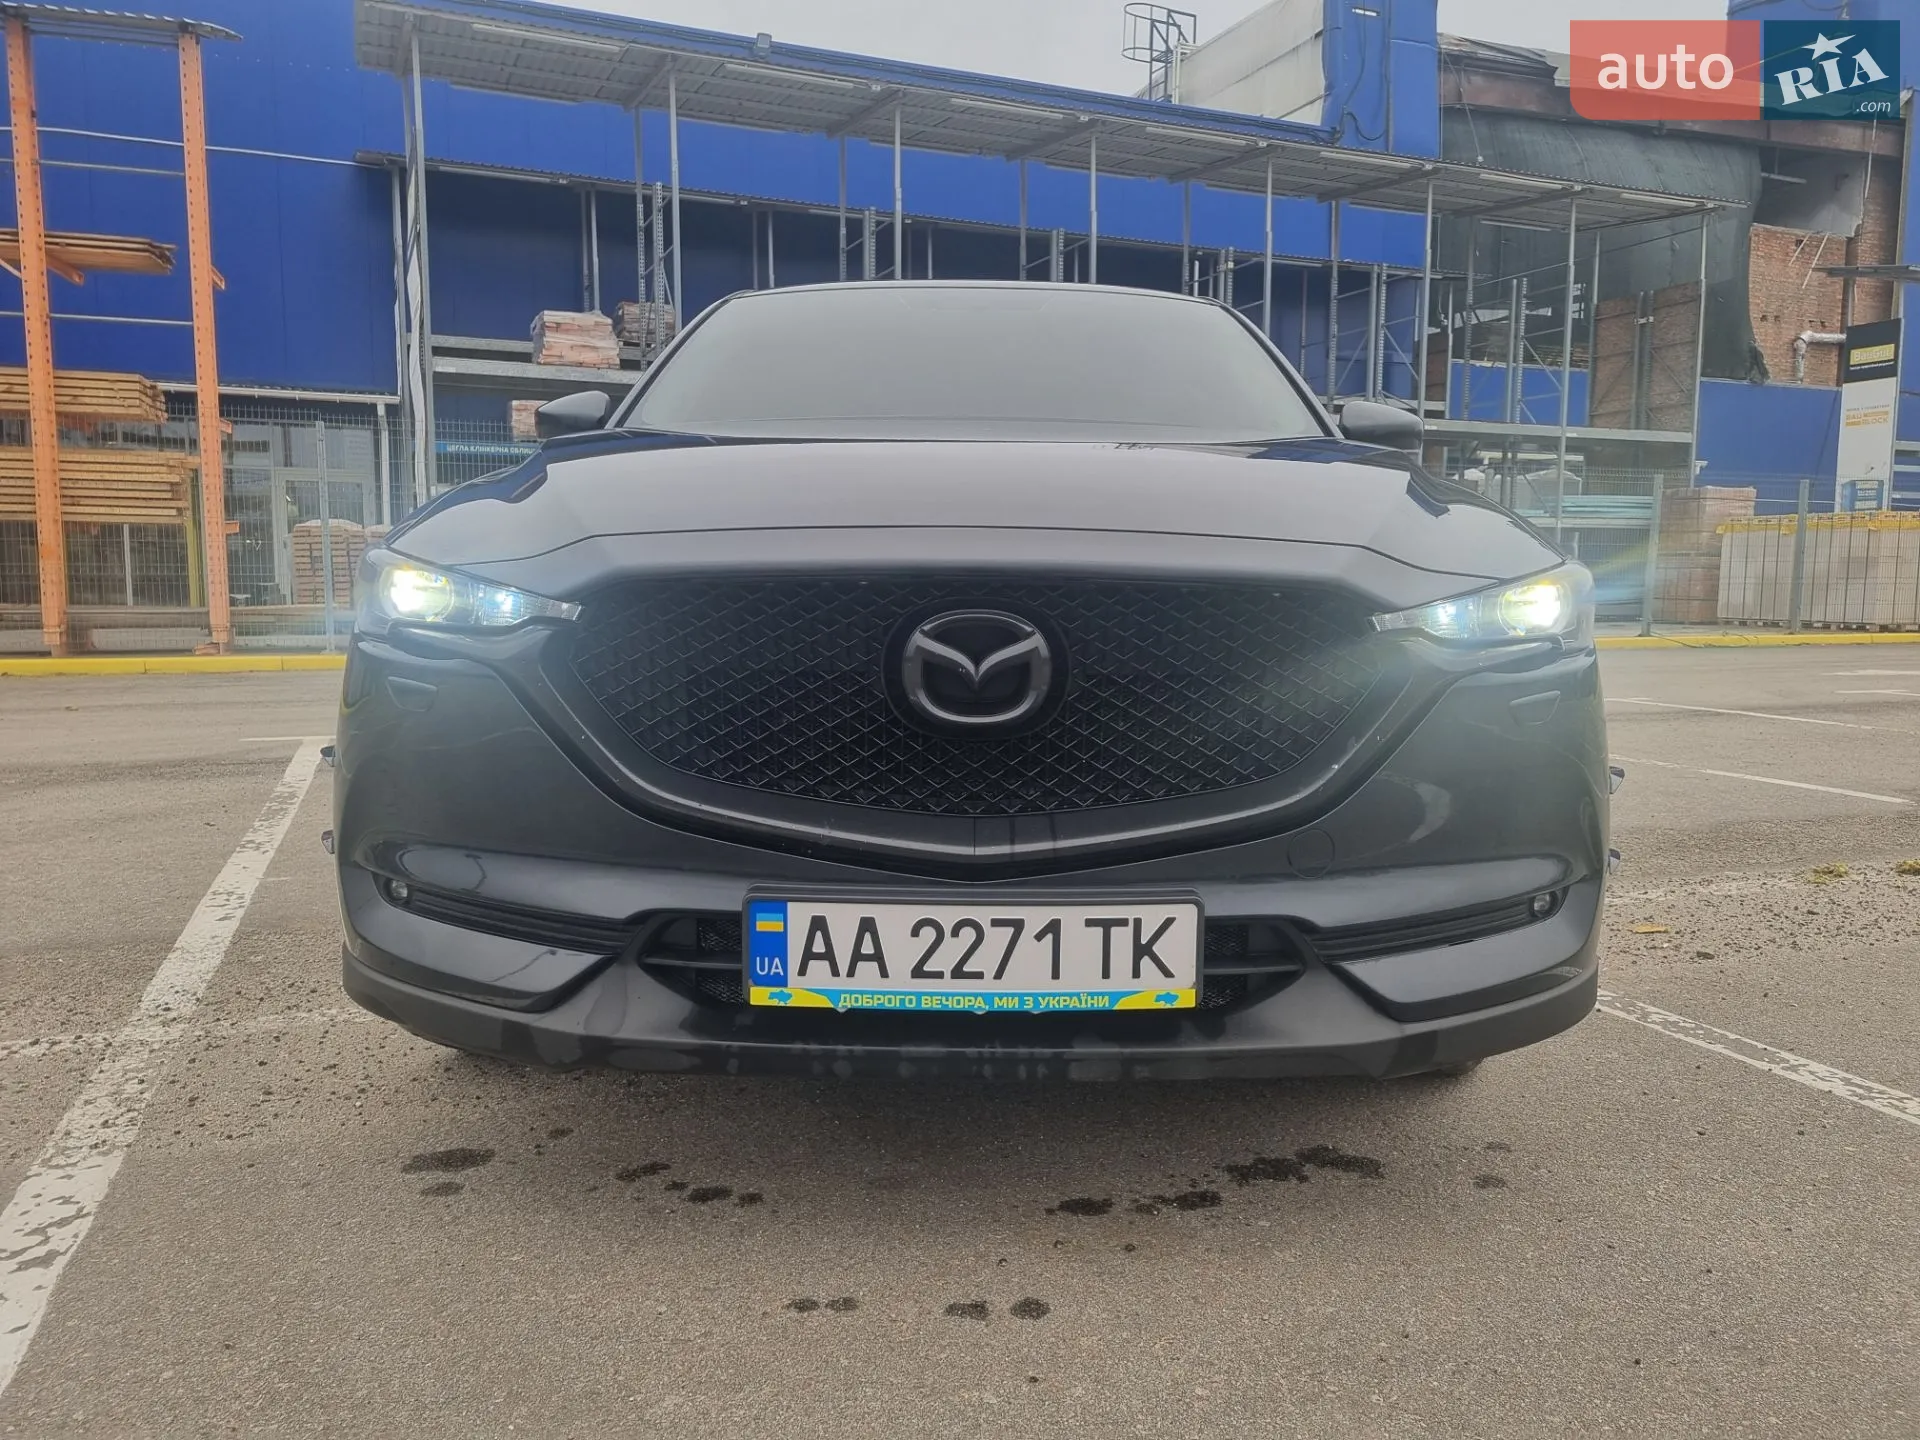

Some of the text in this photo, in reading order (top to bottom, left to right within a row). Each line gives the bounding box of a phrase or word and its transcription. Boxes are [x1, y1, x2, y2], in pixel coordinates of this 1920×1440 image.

[446, 443, 469, 453] ЦЕГЛА
[797, 915, 1177, 980] AA 2271 TK
[756, 956, 784, 976] UA
[838, 993, 916, 1008] ДОБРОГО
[921, 995, 989, 1010] ВЕЧОРА,
[993, 996, 1019, 1009] МИ
[1037, 992, 1110, 1009] УКРАЇНИ
